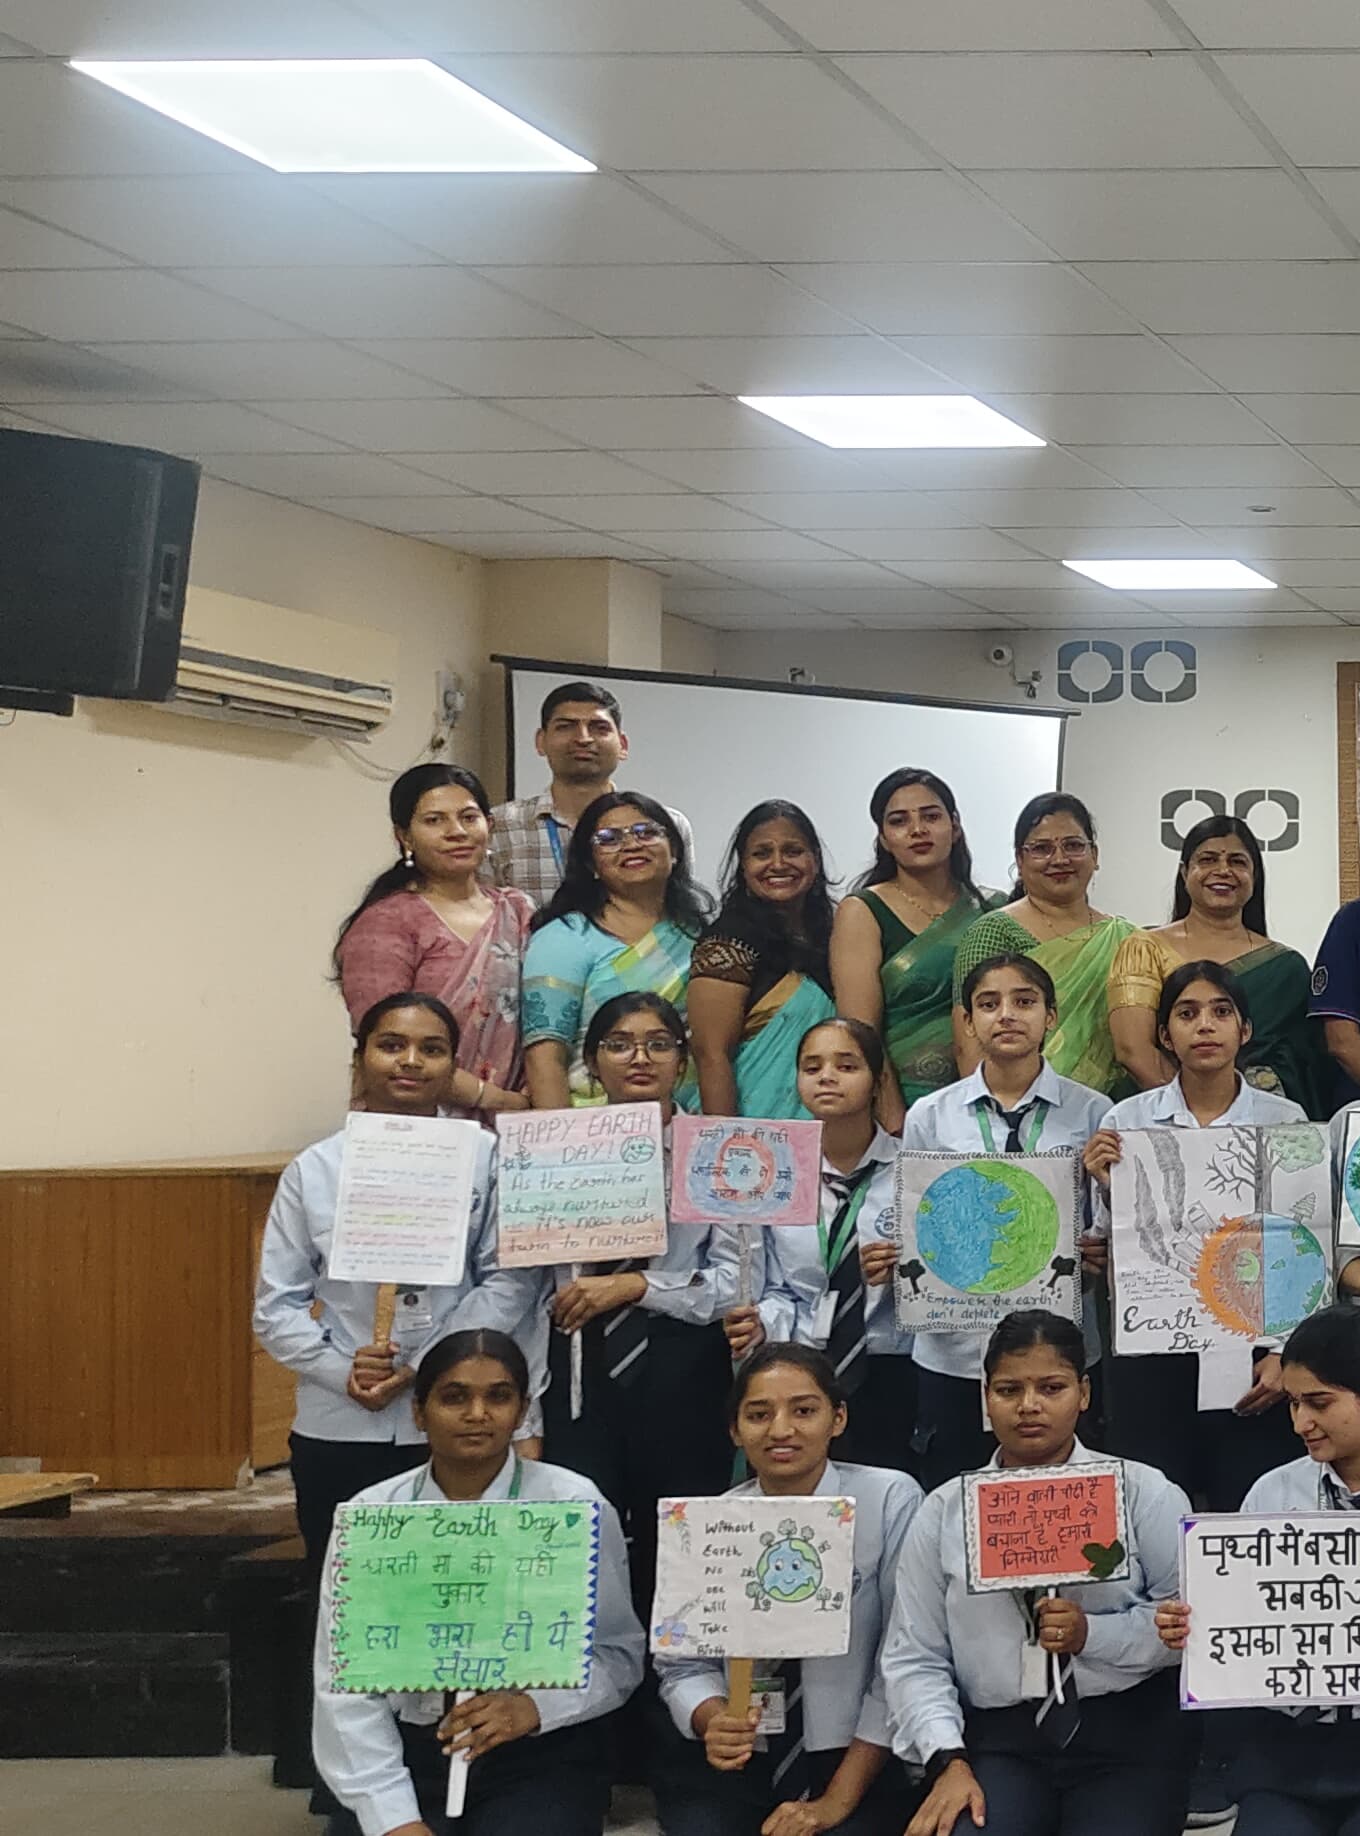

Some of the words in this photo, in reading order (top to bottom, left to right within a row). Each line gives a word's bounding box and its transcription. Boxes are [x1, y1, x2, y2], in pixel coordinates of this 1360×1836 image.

[506, 1117, 576, 1144] HAPPY
[1198, 1527, 1275, 1576] पृथ्वी
[1208, 1625, 1286, 1665] इसका
[1291, 1622, 1335, 1655] सब
